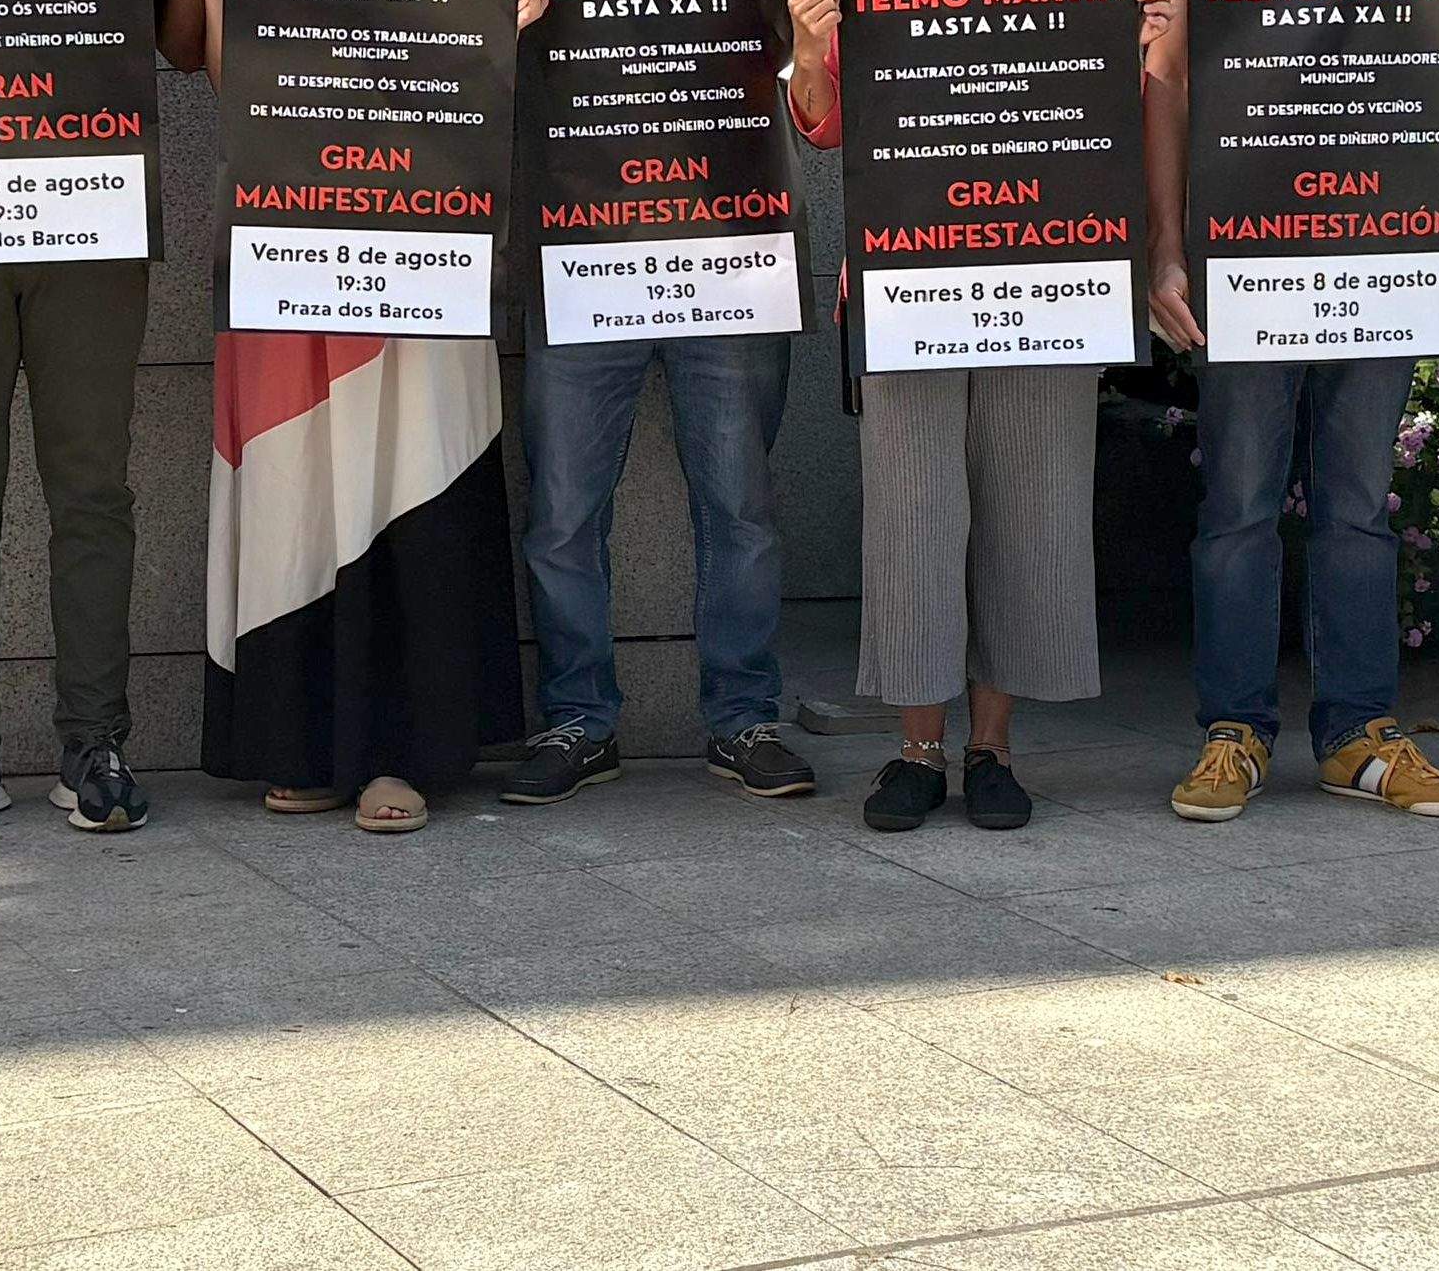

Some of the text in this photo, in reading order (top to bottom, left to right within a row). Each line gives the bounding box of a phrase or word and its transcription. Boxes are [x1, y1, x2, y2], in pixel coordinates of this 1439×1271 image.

[910, 15, 992, 37] BASTA
[1002, 13, 1037, 32] XA
[1261, 6, 1345, 27] BASTA
[1355, 5, 1386, 24] XA
[320, 144, 413, 172] GRAN
[621, 158, 710, 186] GRAN
[947, 179, 1041, 209] GRAN
[1293, 171, 1381, 199] GRAN
[235, 183, 493, 218] MANIFESTACIÓN
[542, 188, 791, 227] MANIFESTACIÓN
[32, 230, 99, 246] Barcos
[864, 213, 1129, 254] MANIFESTACIÓN
[251, 242, 472, 271] Venres 8 de agosto
[883, 278, 1111, 304] Venres 8 de agosto
[592, 307, 755, 328] Praza dos Barcos
[1256, 327, 1414, 346] Praza dos Barcos
